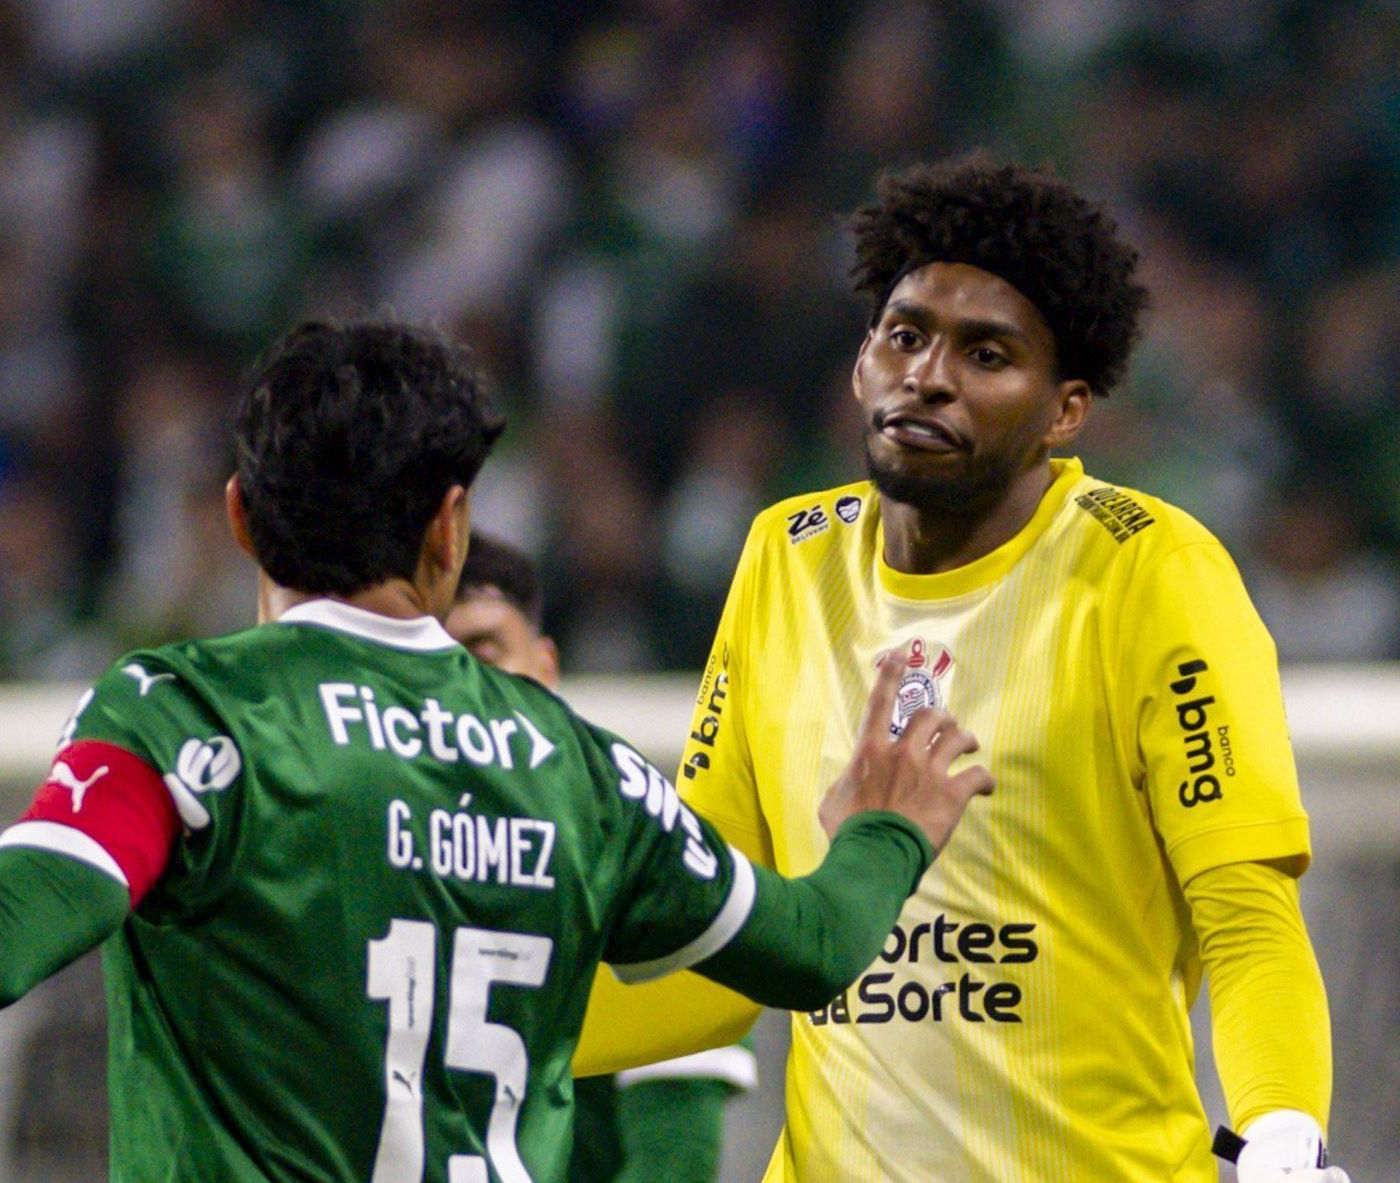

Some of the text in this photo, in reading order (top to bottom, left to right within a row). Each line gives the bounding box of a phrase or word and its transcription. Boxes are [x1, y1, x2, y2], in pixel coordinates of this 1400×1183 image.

[787, 505, 828, 536] Zé
[318, 682, 518, 770] Fictor
[1175, 695, 1224, 809] bmg
[1217, 725, 1236, 777] banco
[387, 799, 423, 871] G.
[429, 792, 557, 890] GÓMEZ
[881, 913, 1039, 964] ortes
[856, 972, 1023, 1024] Sorte
